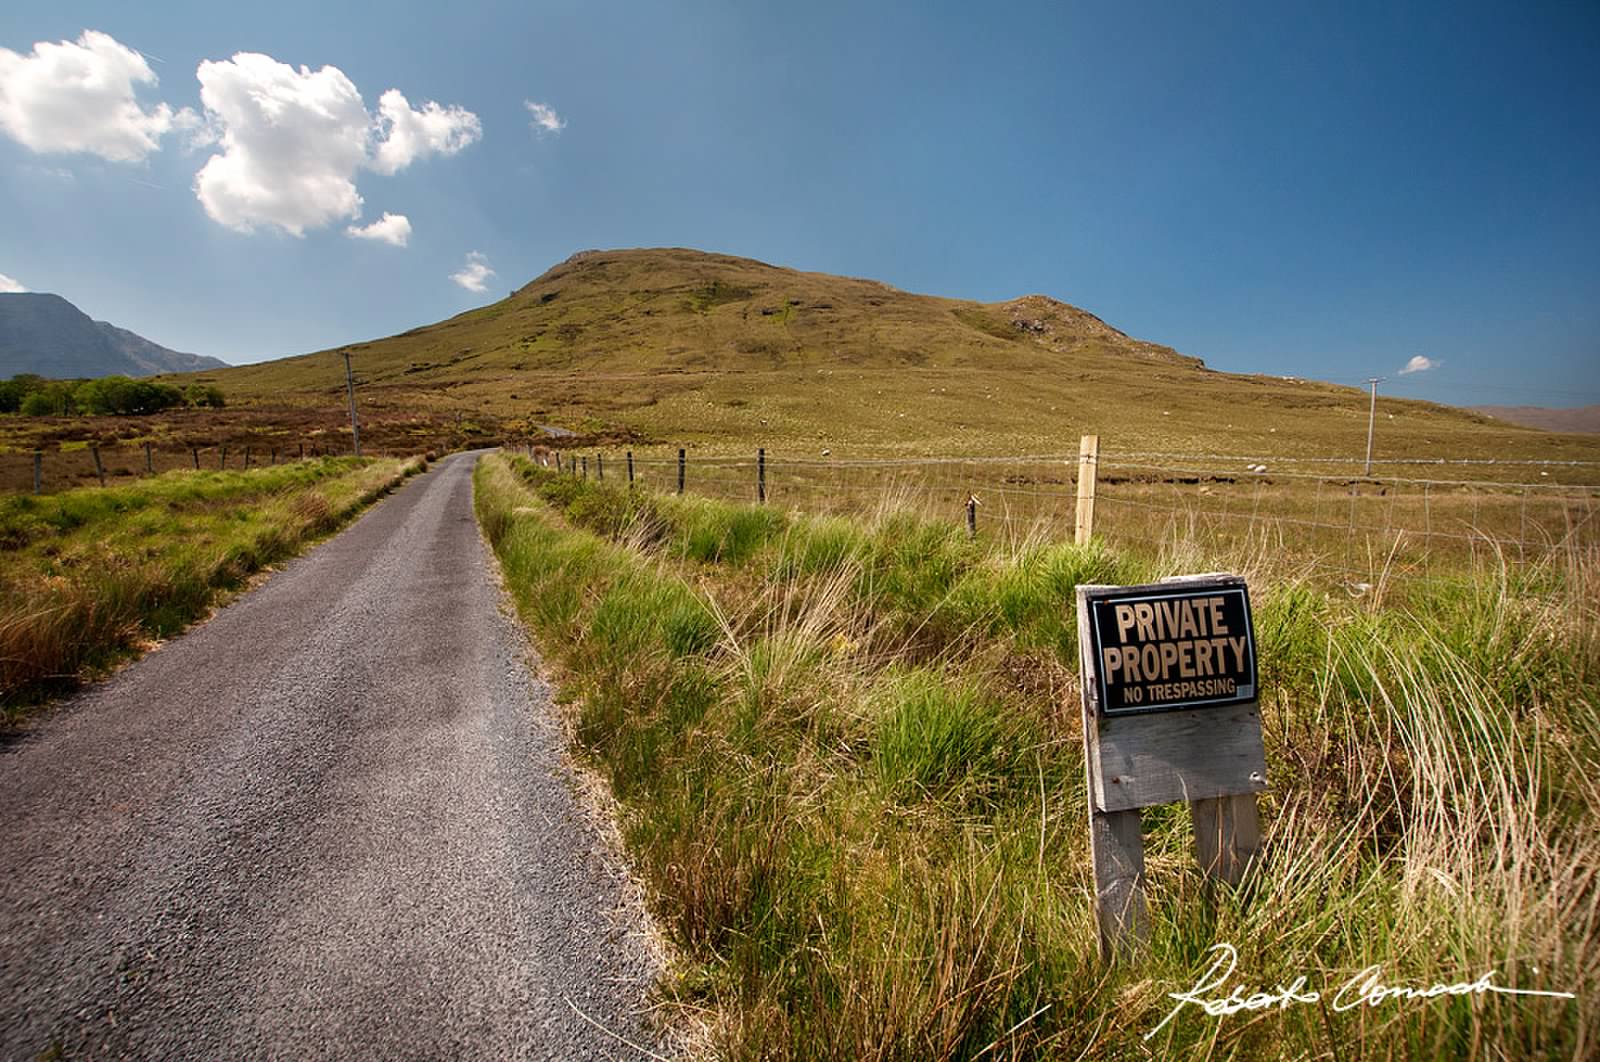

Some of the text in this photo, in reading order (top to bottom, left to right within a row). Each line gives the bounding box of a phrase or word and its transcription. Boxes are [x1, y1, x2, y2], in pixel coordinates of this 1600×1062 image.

[1115, 597, 1229, 643] PRIVATE
[1103, 636, 1246, 684] PROPERTY
[1124, 677, 1236, 703] NO TRESPASSING
